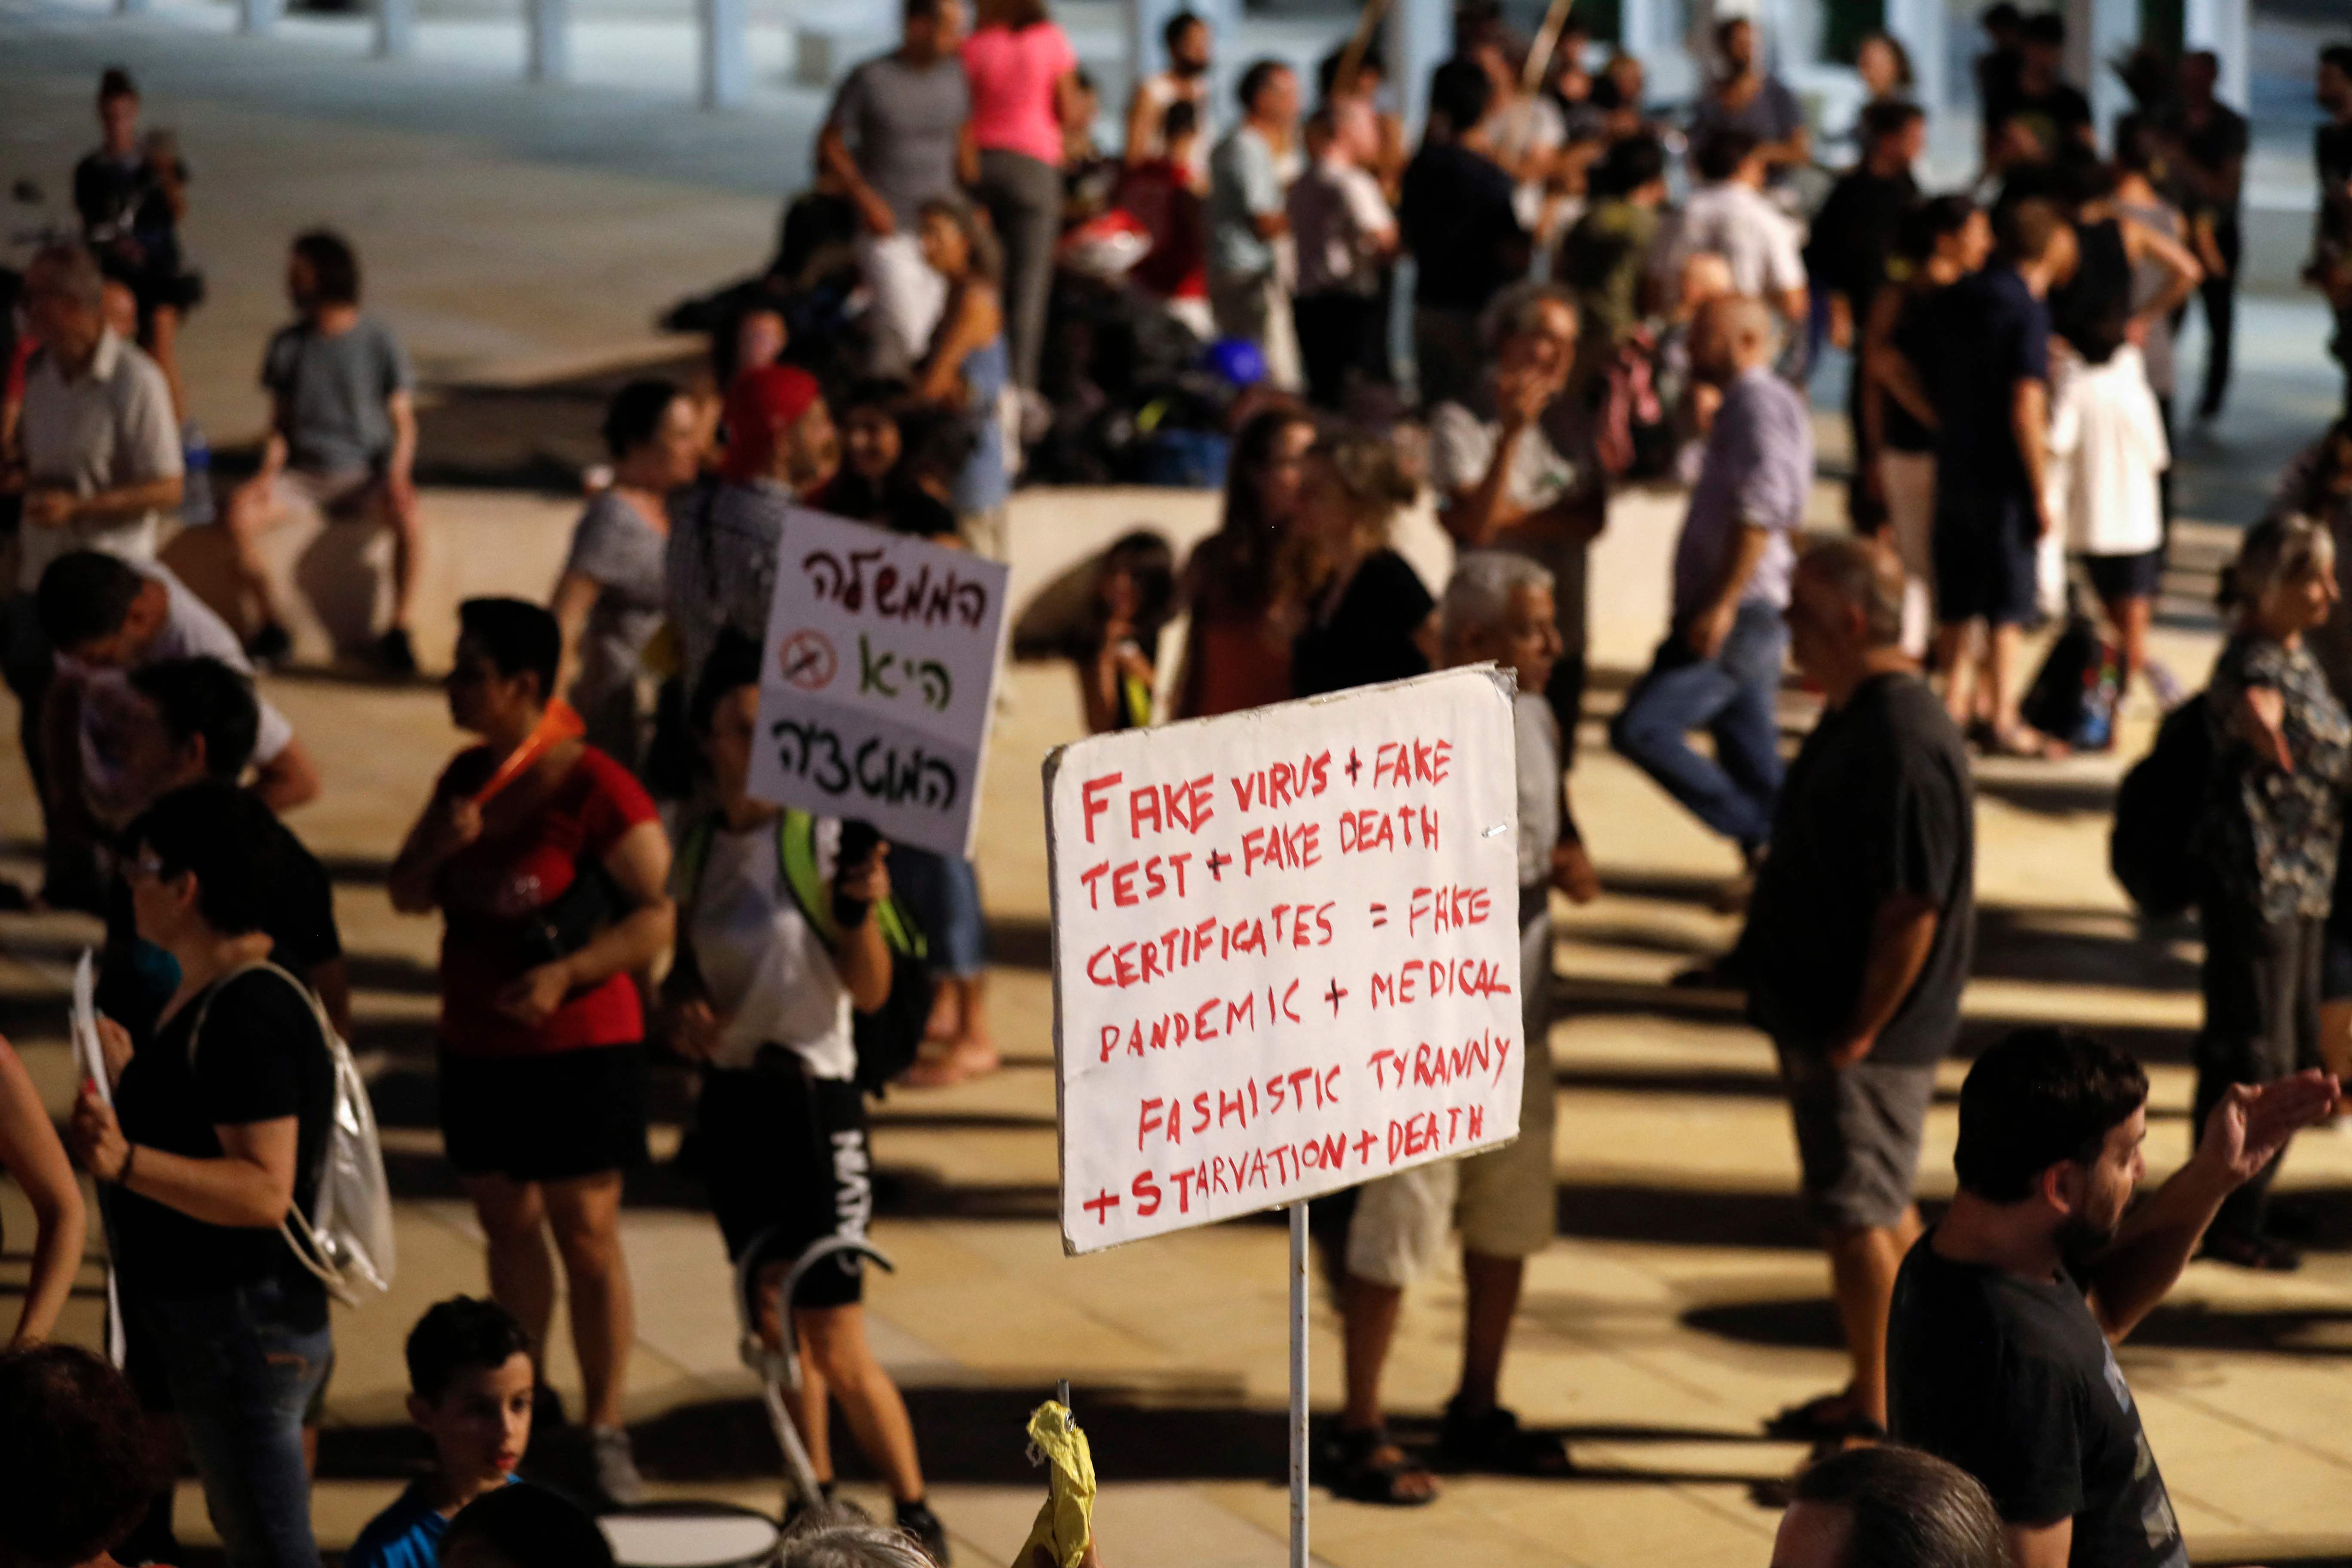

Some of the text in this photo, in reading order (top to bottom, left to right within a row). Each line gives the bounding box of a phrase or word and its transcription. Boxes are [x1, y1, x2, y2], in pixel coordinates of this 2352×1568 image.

[802, 548, 987, 630] הממשלה
[858, 632, 952, 711] היא
[1082, 772, 1214, 844] FAKE
[1231, 750, 1332, 813] VIRUS
[1374, 738, 1453, 789] FAKE
[1080, 852, 1192, 910] TEST
[1242, 822, 1322, 877] FAKE
[1339, 805, 1439, 854] DEATH
[1087, 901, 1335, 987] CERTIFICATES
[1410, 885, 1491, 937] FAKE
[1100, 978, 1300, 1063] PANDEMIC
[1371, 959, 1512, 1010] MEDICAL
[1138, 1028, 1510, 1152] FASHISTIC TYRANNY
[1132, 1132, 1347, 1217] STARVATION
[1387, 1104, 1483, 1165] DEATH
